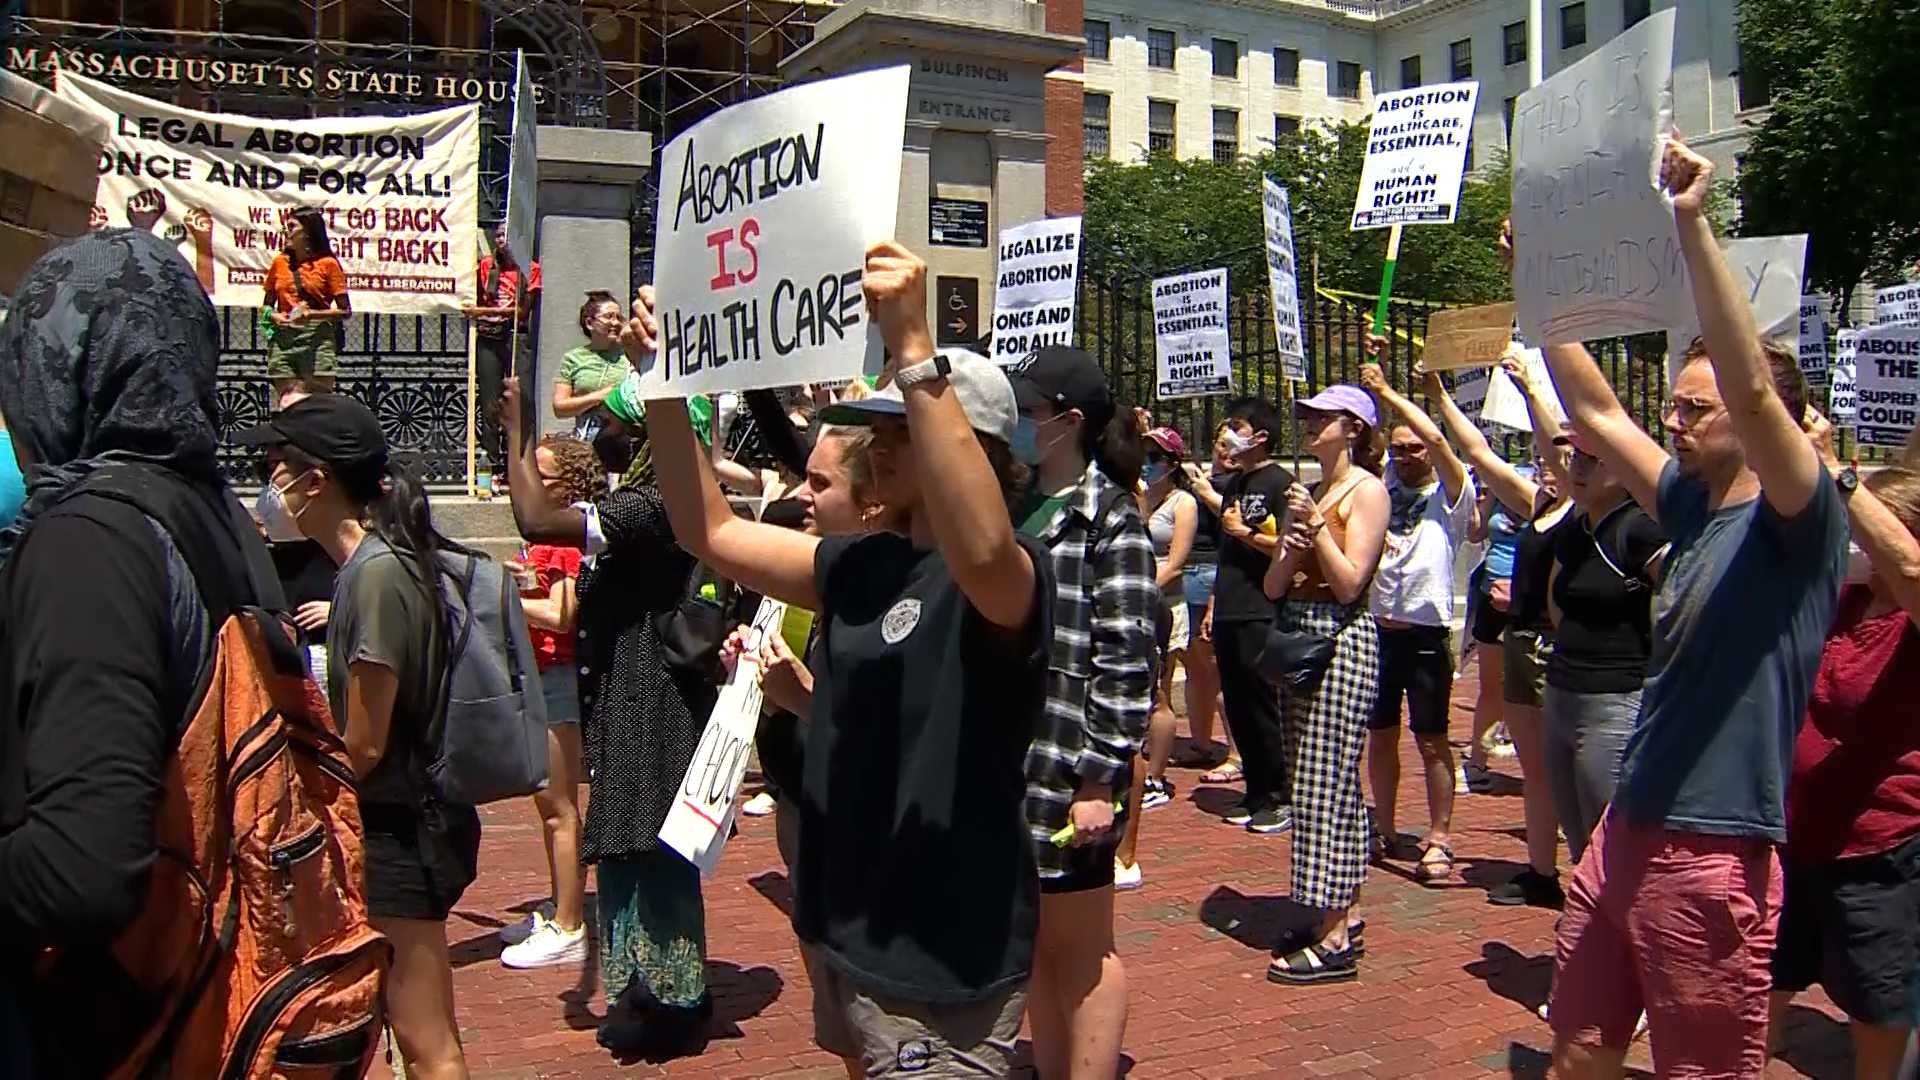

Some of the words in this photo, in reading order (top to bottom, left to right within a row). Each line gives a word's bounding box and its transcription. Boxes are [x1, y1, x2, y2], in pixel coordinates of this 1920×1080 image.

[8, 47, 313, 89] MASSACHUSETTS
[326, 68, 422, 95] STATE
[919, 100, 1011, 122] ENTRANCE
[1378, 90, 1470, 113] ABORTION
[1413, 109, 1424, 120] IS
[117, 112, 234, 149] LEGAL
[245, 126, 425, 160] ABORTION
[1373, 117, 1463, 138] HEALTHCARE,
[1370, 132, 1461, 155] ESSENTIAL,
[97, 150, 192, 180] ONCE
[206, 160, 285, 190] AND
[299, 166, 367, 195] FOR
[379, 172, 451, 197] ALL!
[673, 122, 825, 232] ABORTION
[1374, 173, 1437, 191] HUMAN
[1373, 190, 1436, 208] RIGHT!
[249, 205, 272, 226] WE
[347, 207, 377, 230] GO
[385, 207, 449, 232] BACK
[234, 228, 257, 250] WE
[378, 236, 449, 267] BACK!
[706, 217, 761, 291] IS
[1001, 233, 1075, 263] LEGALIZE
[230, 270, 269, 283] PARTY
[382, 278, 453, 290] LIBERATION
[999, 263, 1074, 290] ABORTION
[1155, 275, 1221, 298] ABORTION
[1157, 301, 1222, 320] HEALTHCARE,
[1182, 295, 1192, 304] IS
[663, 298, 761, 382] HEALTH
[770, 268, 864, 356] CARE
[996, 310, 1034, 331] ONCE
[1036, 307, 1071, 326] AND
[1158, 315, 1224, 335] ESSENTIAL,
[1879, 311, 1920, 325] HEALTH
[996, 335, 1028, 356] FOR
[1168, 351, 1213, 366] HUMAN
[1874, 358, 1919, 379] THE
[1170, 363, 1214, 380] RIGHT!
